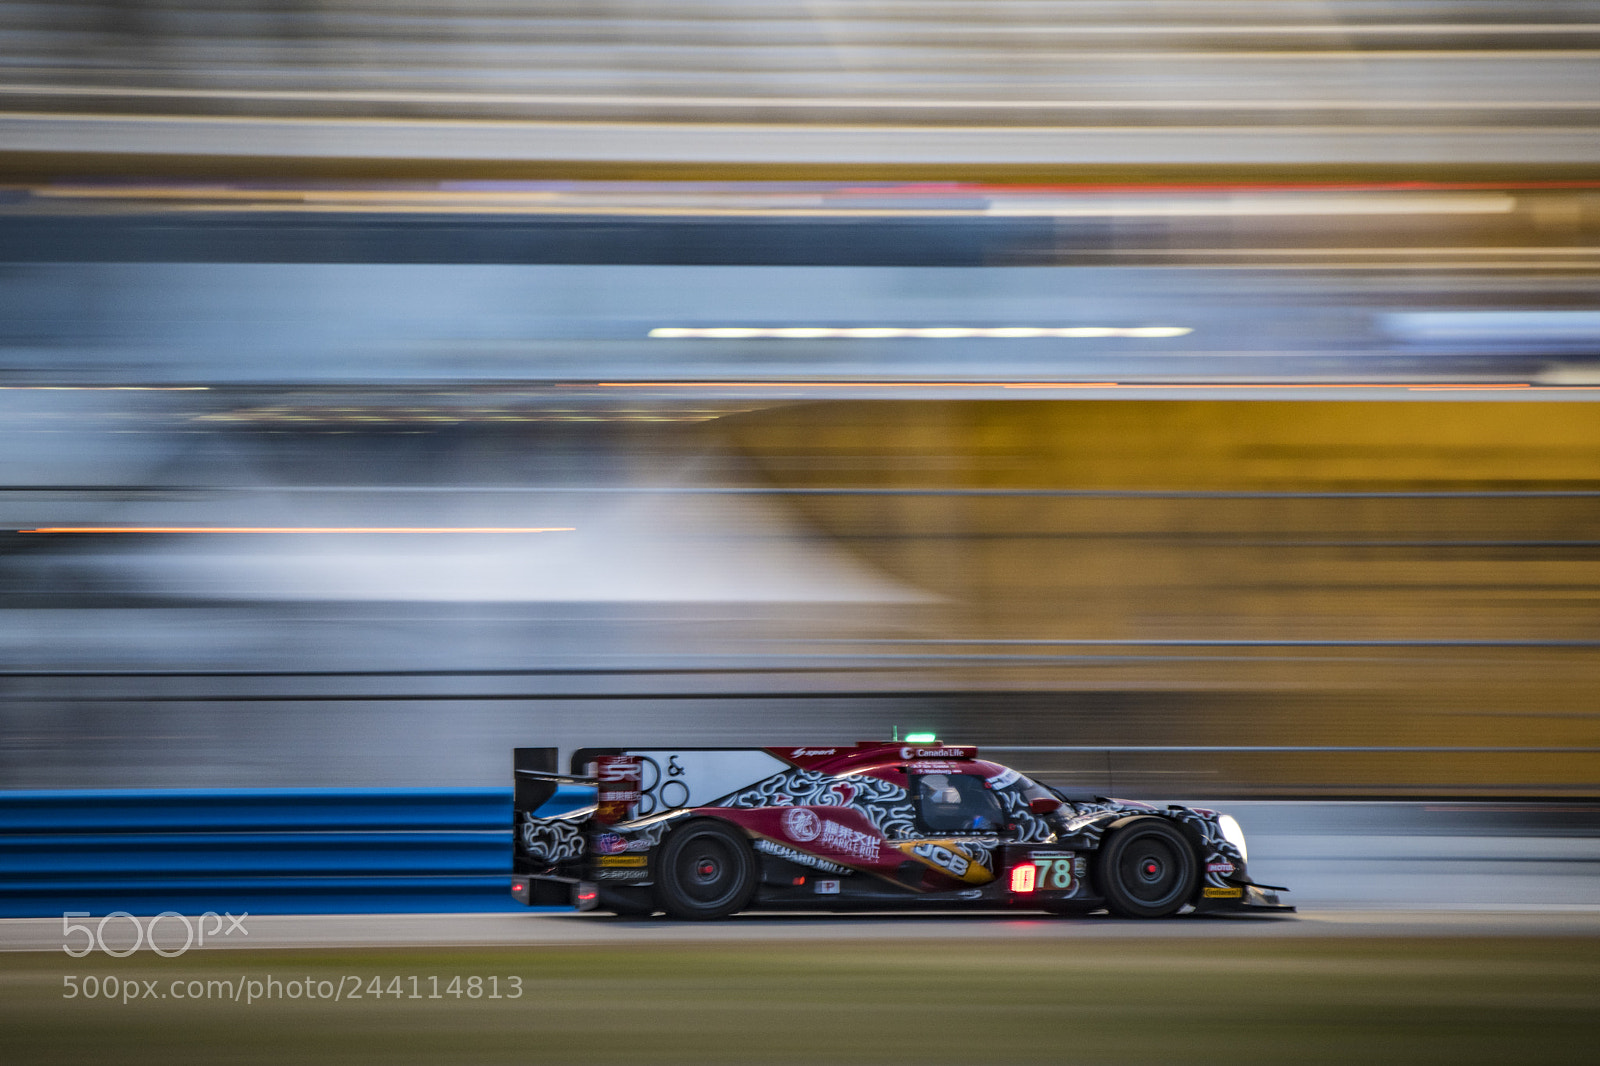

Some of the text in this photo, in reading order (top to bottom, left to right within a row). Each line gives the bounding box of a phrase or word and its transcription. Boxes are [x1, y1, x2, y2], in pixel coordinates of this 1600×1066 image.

[917, 748, 965, 757] Canada Life
[760, 839, 817, 866] RICHARD
[823, 832, 859, 853] SPARKLE
[859, 845, 880, 859] ROLL
[914, 844, 969, 876] JCB
[1034, 859, 1071, 889] 78
